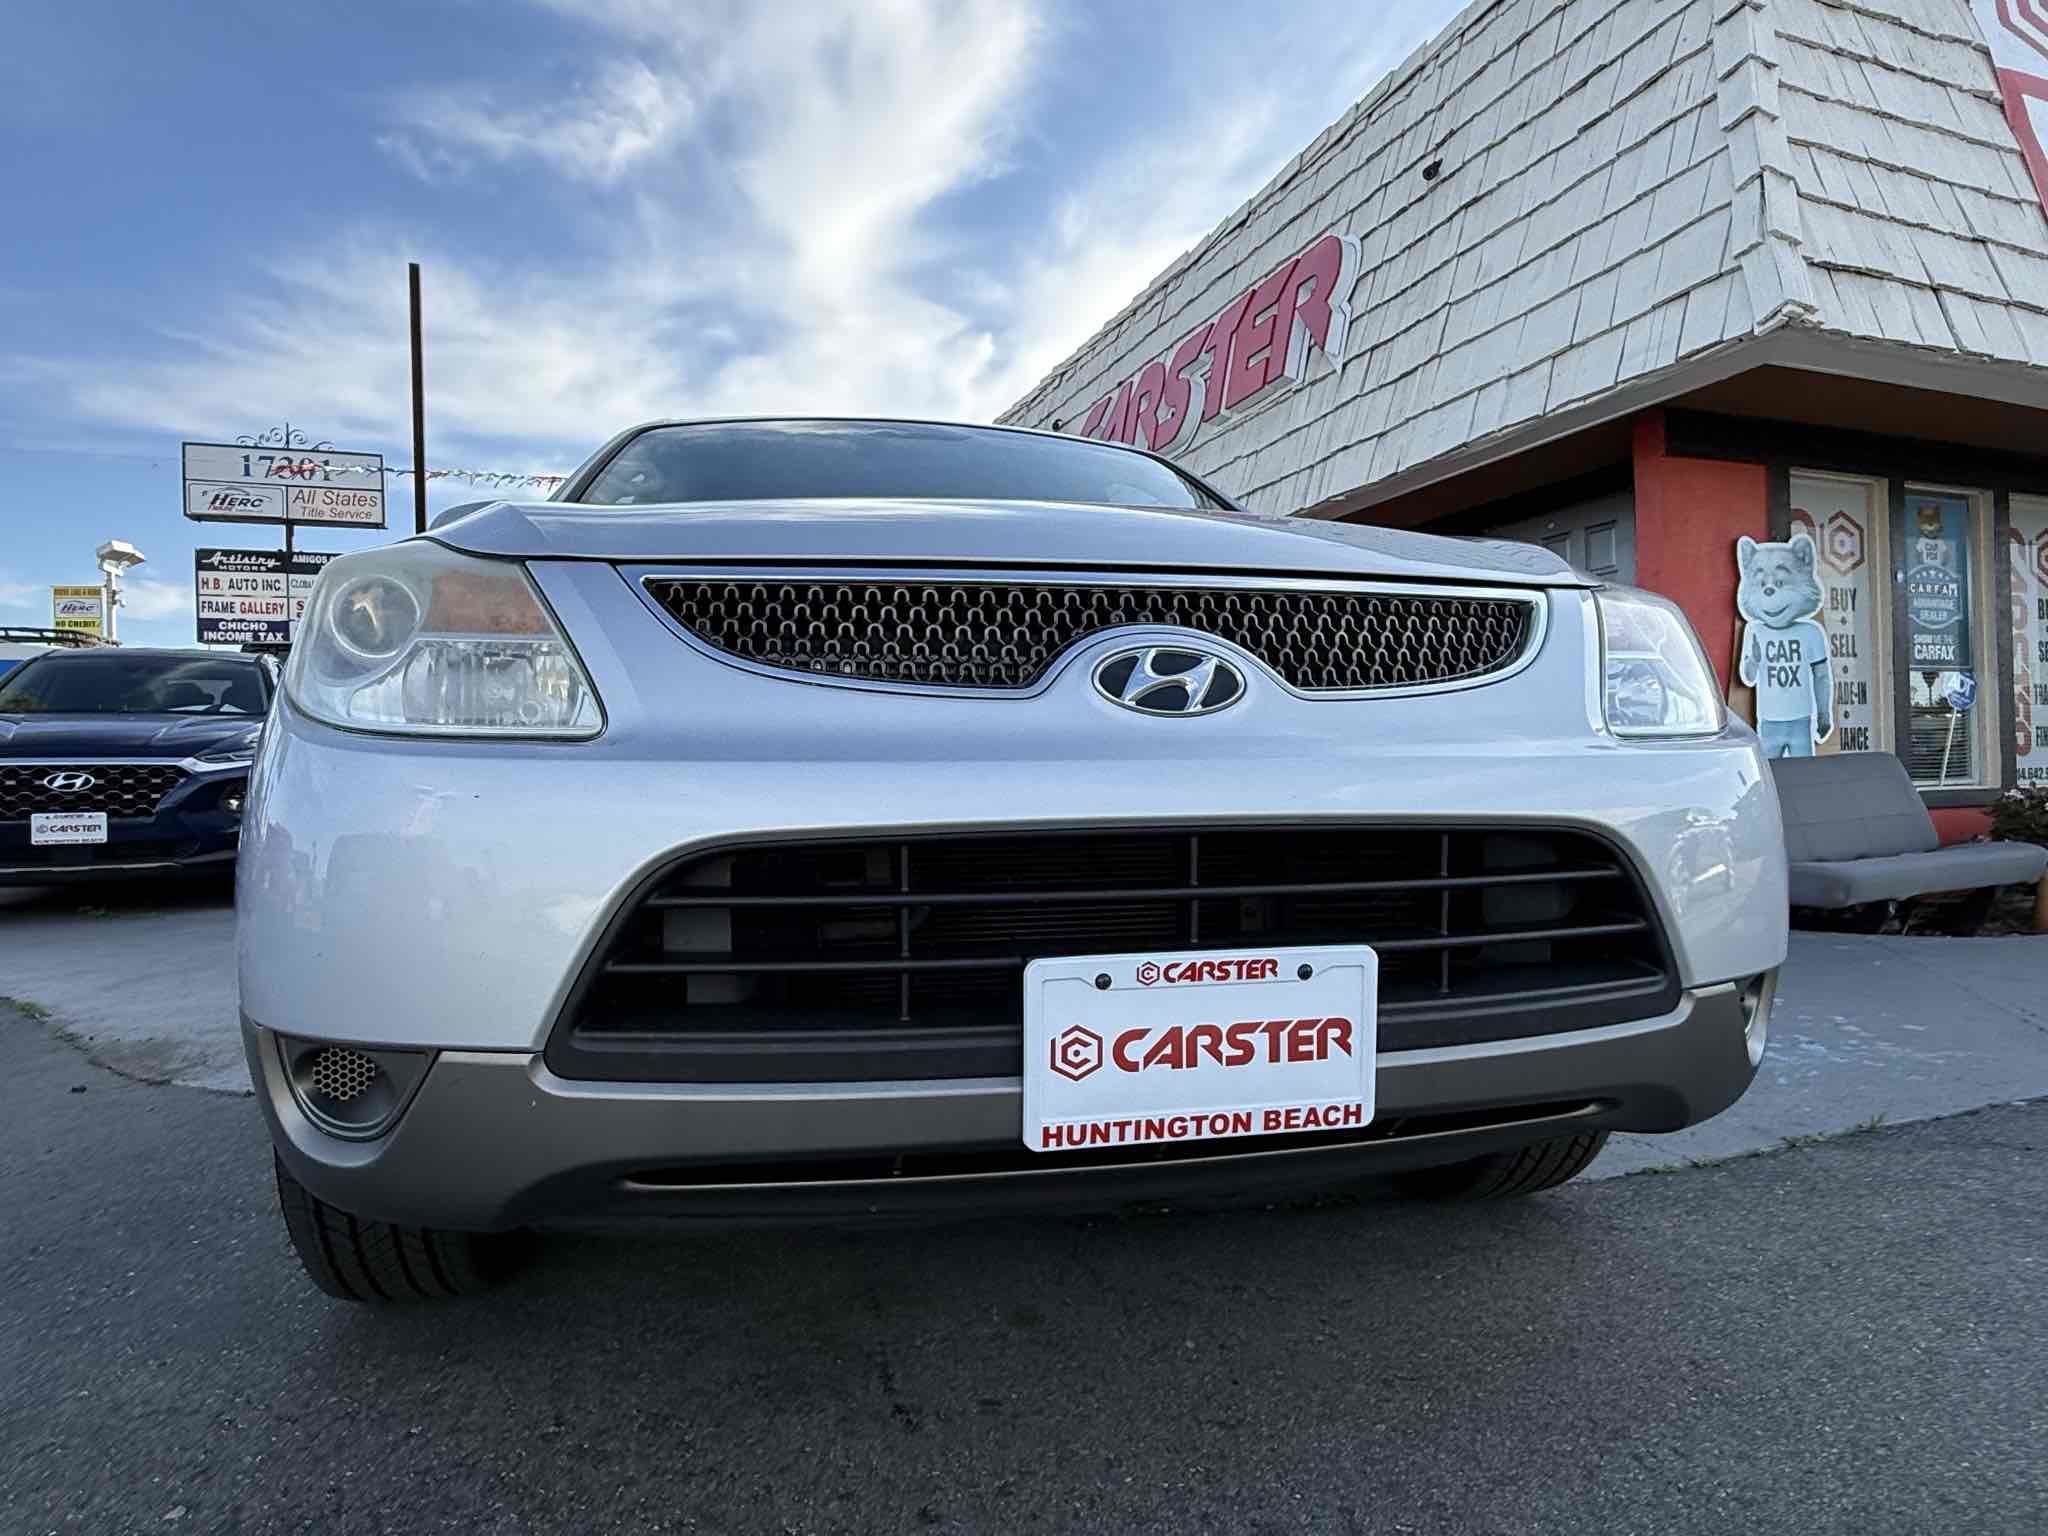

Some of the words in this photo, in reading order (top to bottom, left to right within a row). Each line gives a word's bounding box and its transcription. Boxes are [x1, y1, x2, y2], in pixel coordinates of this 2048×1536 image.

[1080, 234, 1350, 455] CARSTER
[293, 488, 316, 505] All
[322, 490, 377, 507] States
[301, 507, 325, 518] Title
[328, 507, 373, 521] Service
[201, 551, 282, 567] Artistry
[291, 553, 328, 564] AMIGOS
[228, 578, 259, 591] AUTO
[201, 600, 236, 614] FRAME
[240, 601, 286, 615] GALLERY
[1830, 586, 1857, 612] BUY
[203, 631, 254, 642] INCOME
[258, 632, 285, 642] TAX
[218, 621, 269, 631] CHICHO
[1765, 639, 1802, 664] CAR
[1831, 634, 1858, 658] SELL
[1914, 643, 1955, 661] CARFAX
[1766, 664, 1803, 688] FOX
[1947, 671, 1976, 697] ADT
[1837, 681, 1868, 705] ADE-IN
[1163, 958, 1279, 983] CARSTER
[1112, 1017, 1353, 1073] CARSTER
[1041, 1112, 1252, 1149] HUNTINGTON
[1263, 1103, 1363, 1132] BEACH
